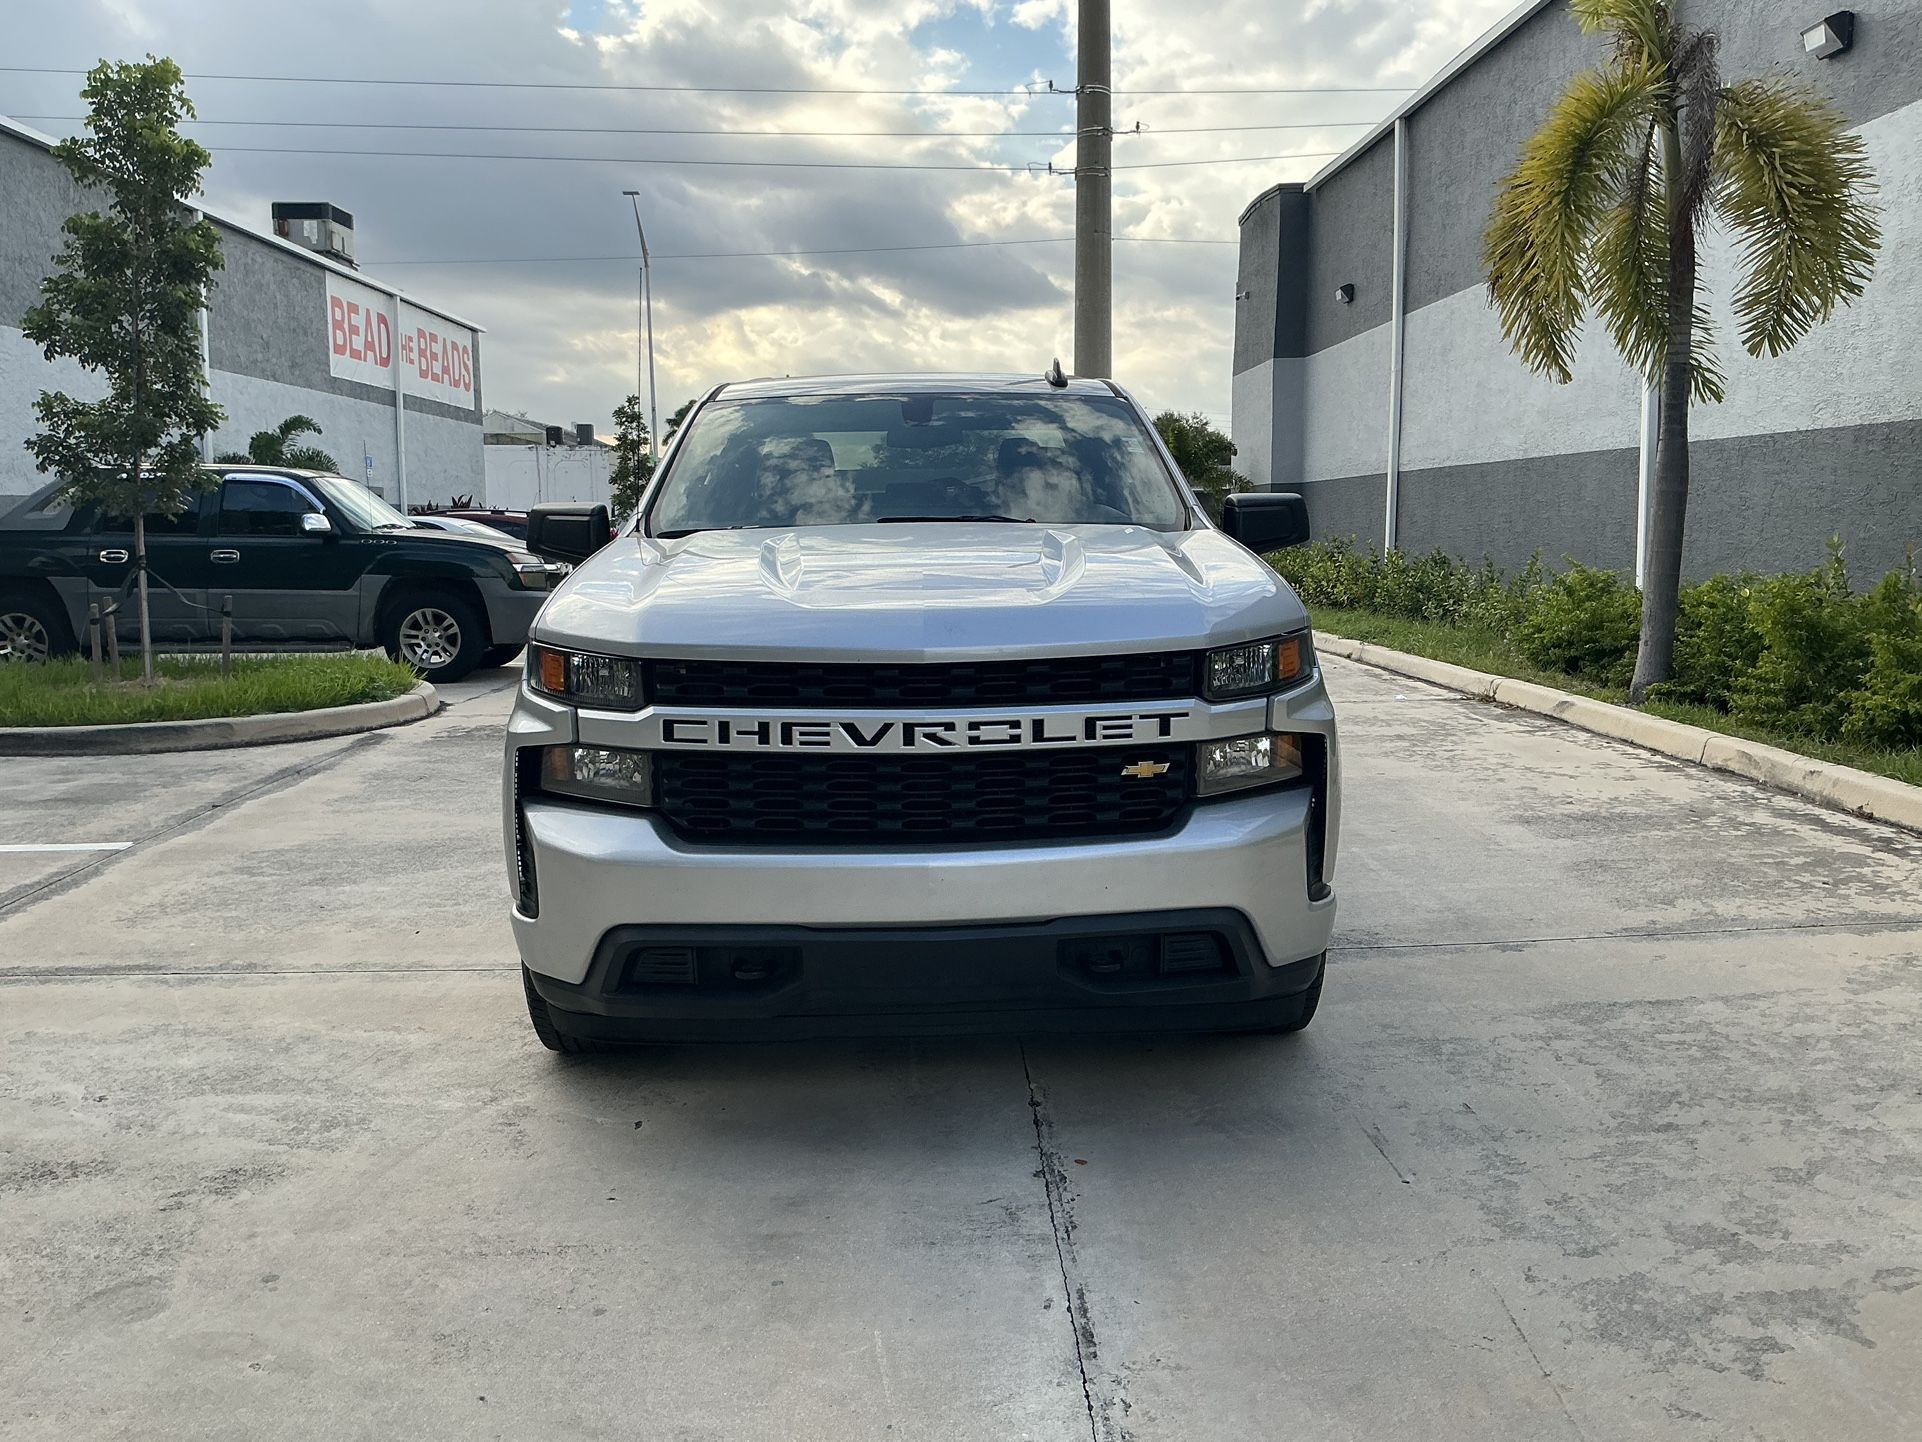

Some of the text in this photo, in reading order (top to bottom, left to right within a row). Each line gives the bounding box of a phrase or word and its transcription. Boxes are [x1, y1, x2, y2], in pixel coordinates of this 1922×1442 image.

[330, 294, 472, 393] BEAD HE BEADS
[661, 711, 1190, 748] CHEVROLET
